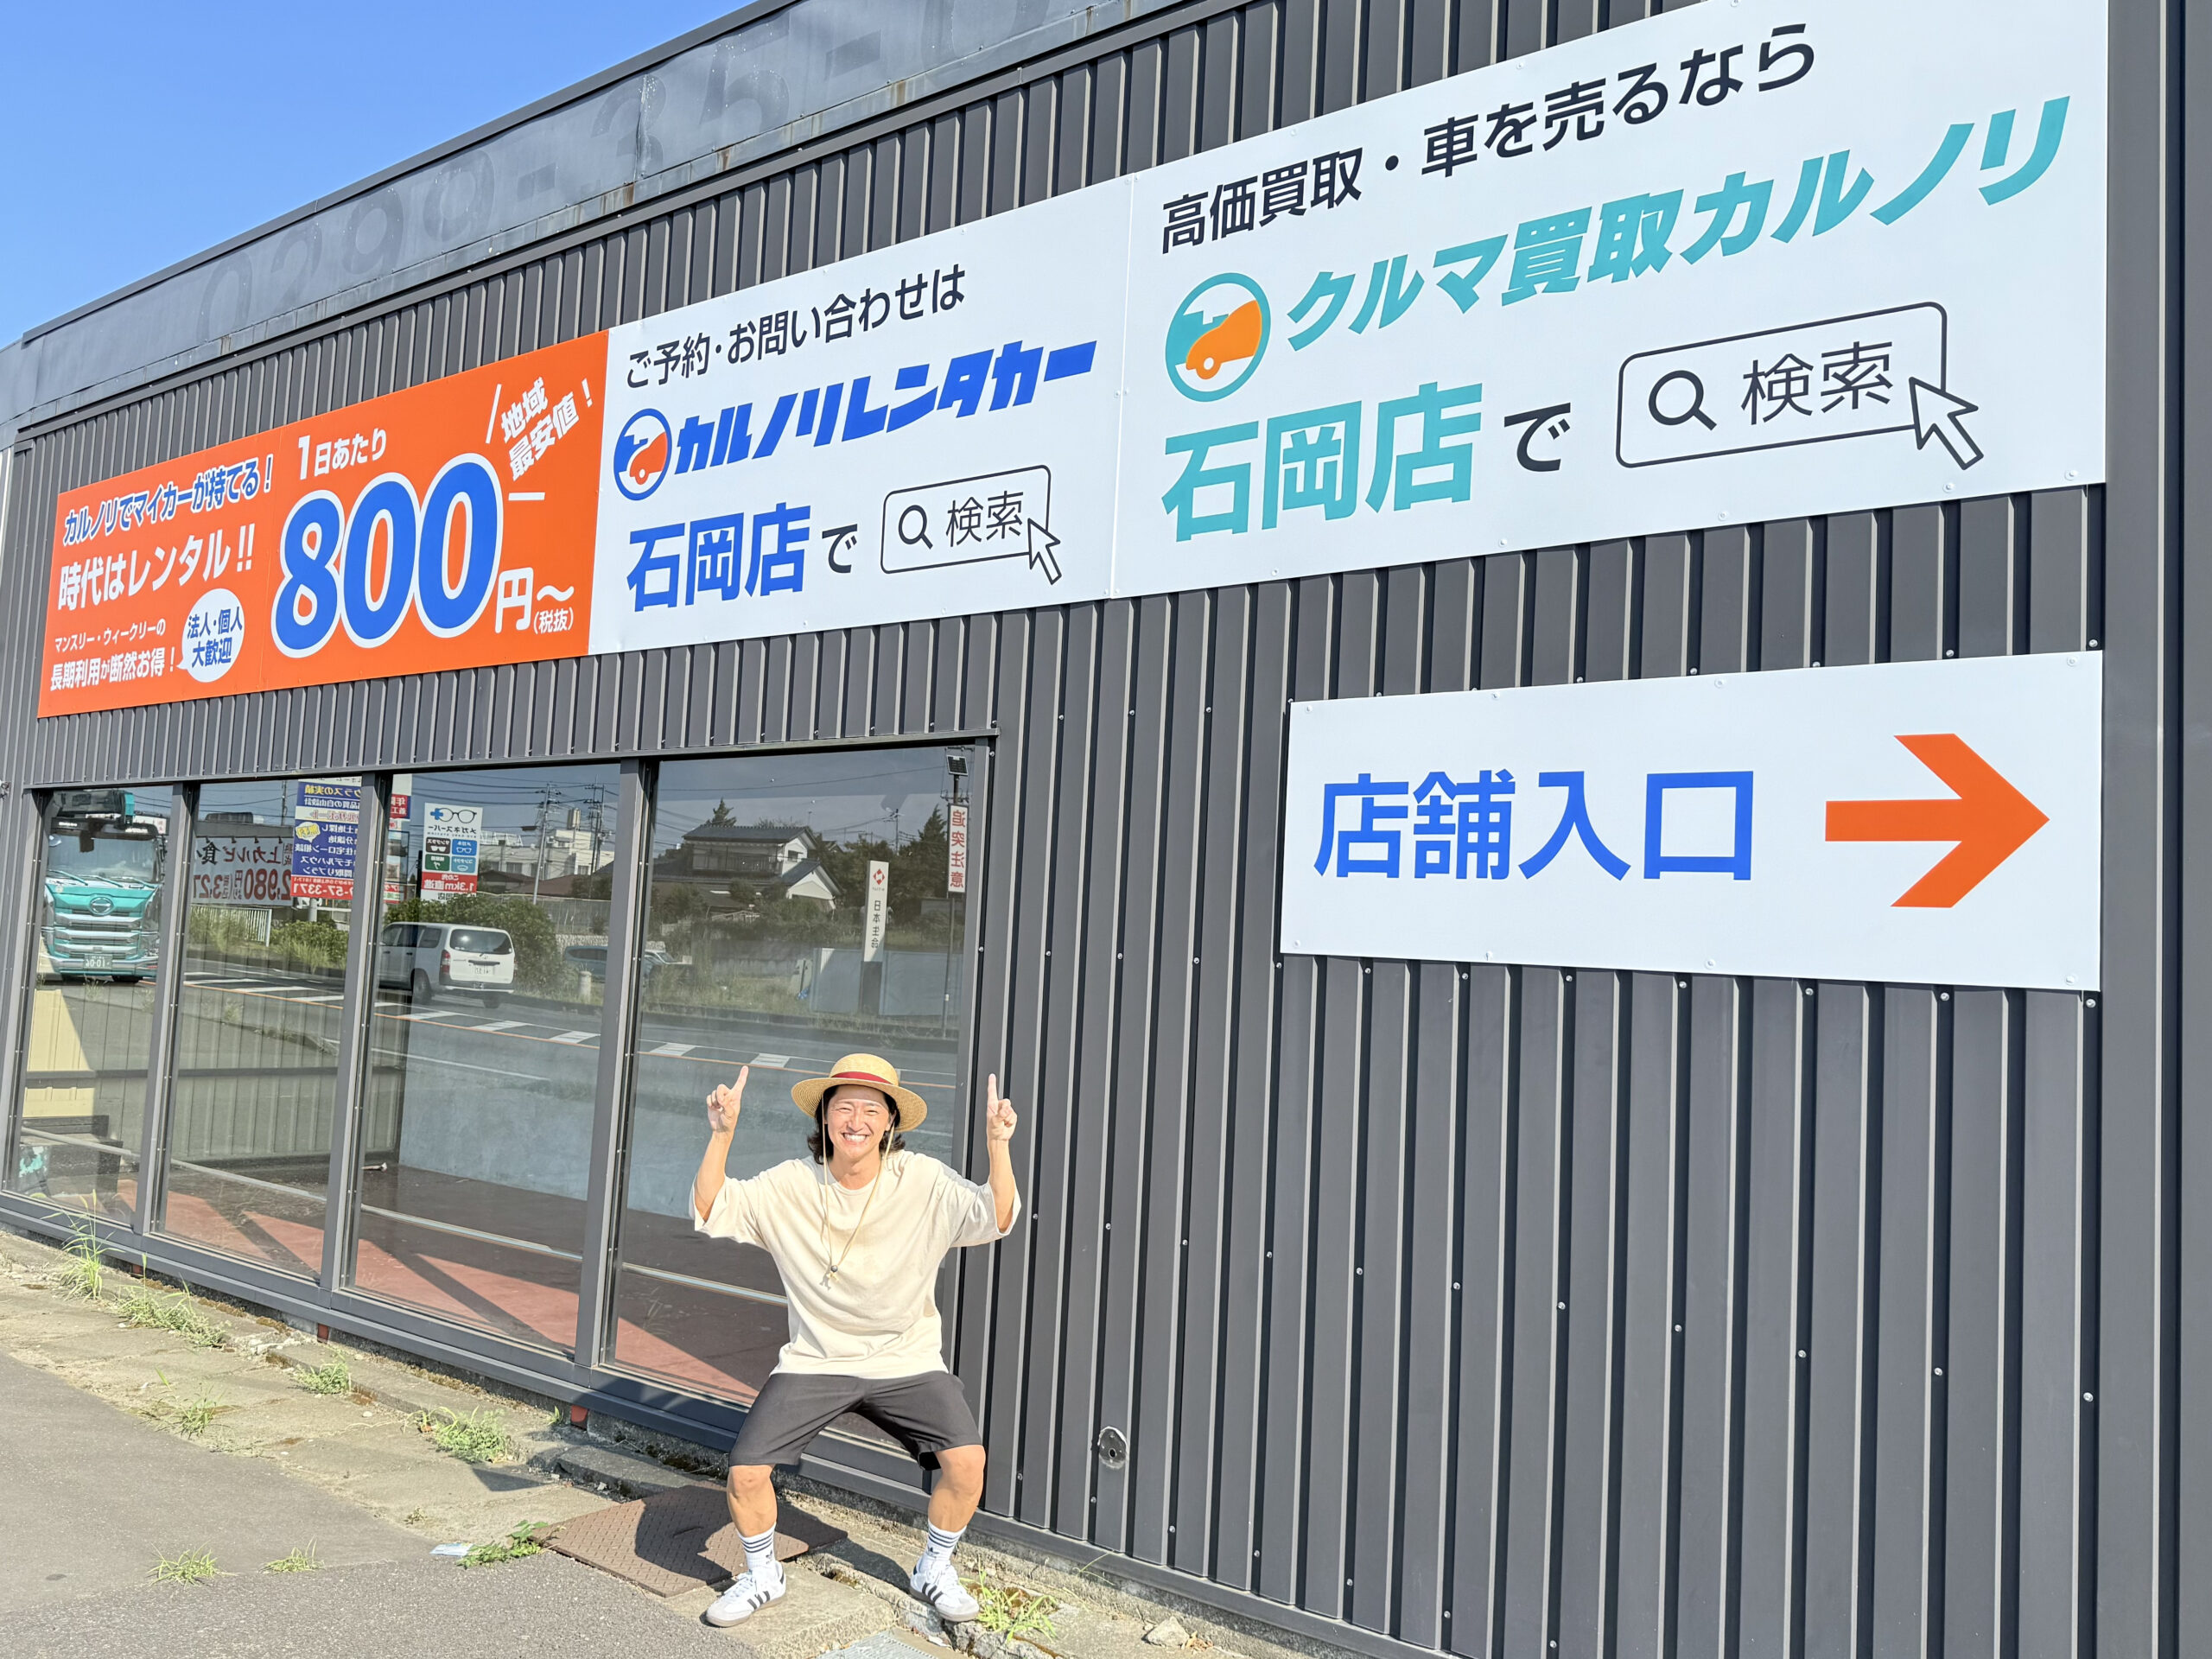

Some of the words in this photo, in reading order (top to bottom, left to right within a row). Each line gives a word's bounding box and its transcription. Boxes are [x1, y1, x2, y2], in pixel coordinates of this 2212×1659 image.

[1160, 22, 1816, 255] 高価買取・車を売るなら
[1285, 95, 2070, 351] クルマ買取カルノリ
[626, 264, 966, 389] ご予約・お問い合わせは
[501, 377, 548, 443] 地域
[673, 340, 1097, 475] カルノリレンタカー
[1740, 340, 1894, 426] 検索
[298, 428, 387, 480] 1日あたり
[508, 378, 594, 481] 最安値！
[63, 454, 274, 546] カルノリでマイカーが持てる！
[945, 489, 1024, 547] 検索
[58, 524, 255, 611] 時代はレンタル!!
[54, 618, 166, 653] マンスリー・ウィークリーの
[187, 607, 243, 639] 法人・個人
[192, 637, 232, 668] 大歓迎
[533, 607, 574, 634] (税抜)
[50, 646, 175, 691] 長期利用が断然お得！
[1313, 767, 1754, 881] 店舗入口
